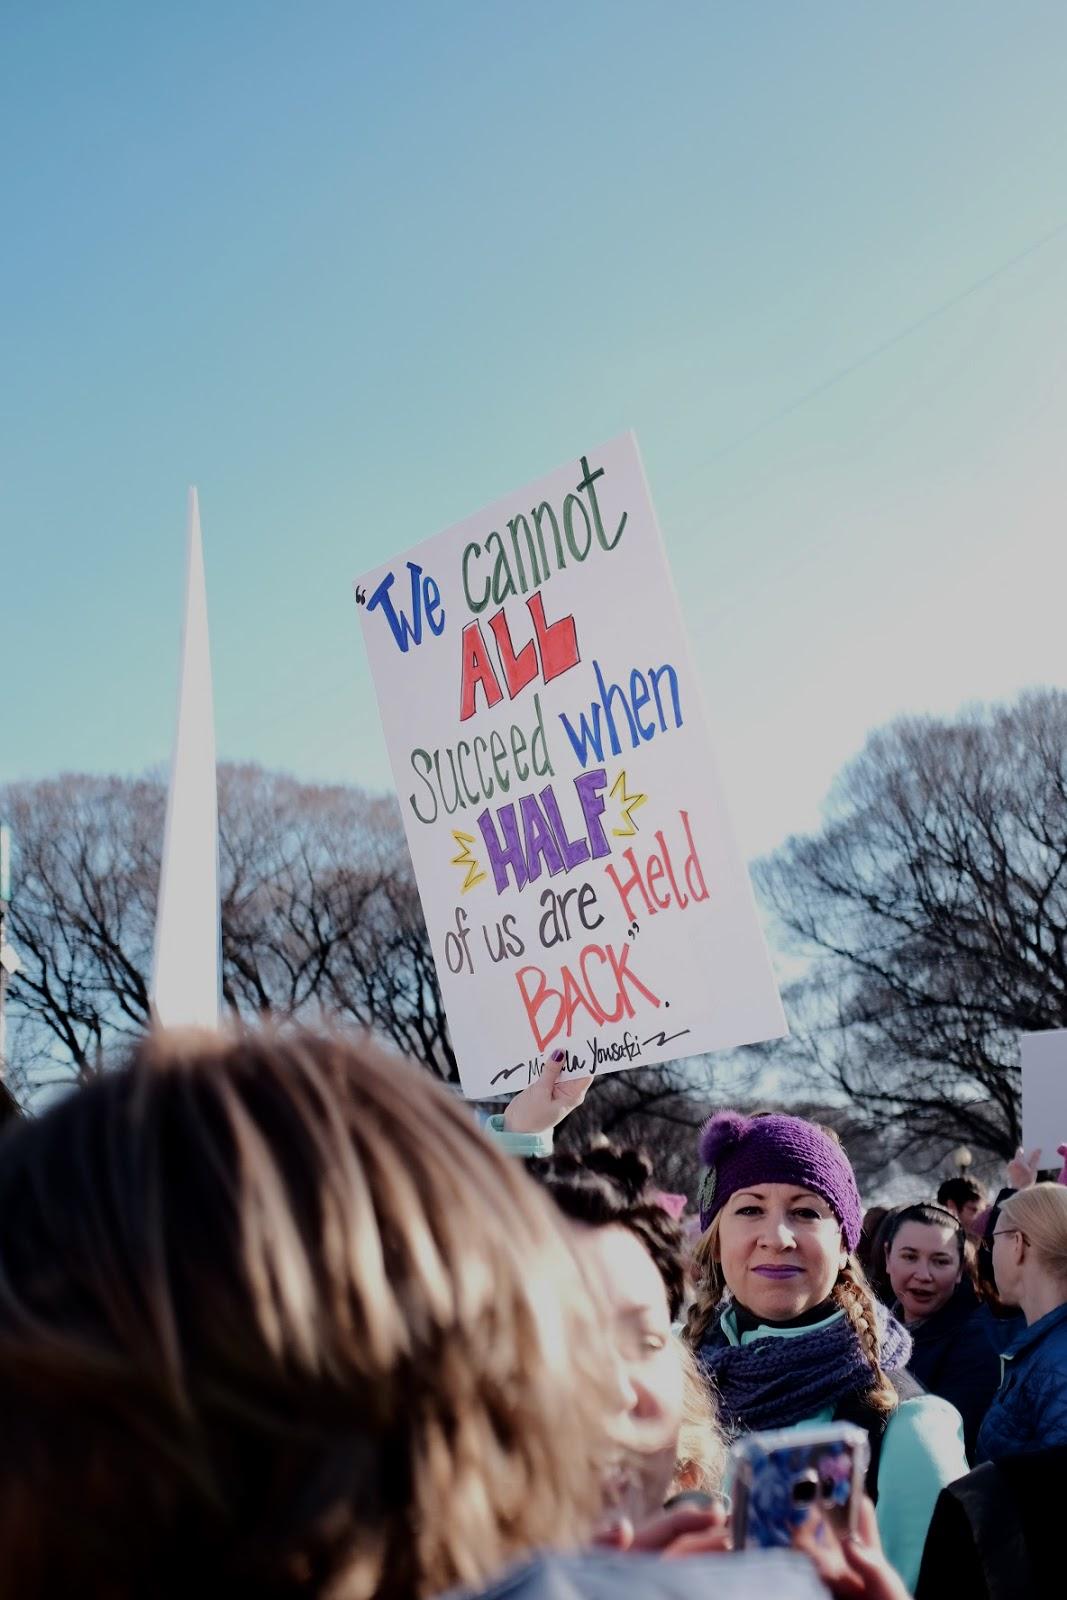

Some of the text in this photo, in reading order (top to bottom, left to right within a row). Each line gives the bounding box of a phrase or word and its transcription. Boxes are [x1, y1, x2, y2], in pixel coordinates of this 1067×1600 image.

[462, 456, 628, 614] cannot
[459, 590, 582, 722] ALL
[558, 660, 684, 768] when
[444, 810, 710, 975] of us are Held
[476, 768, 612, 896] HALF
